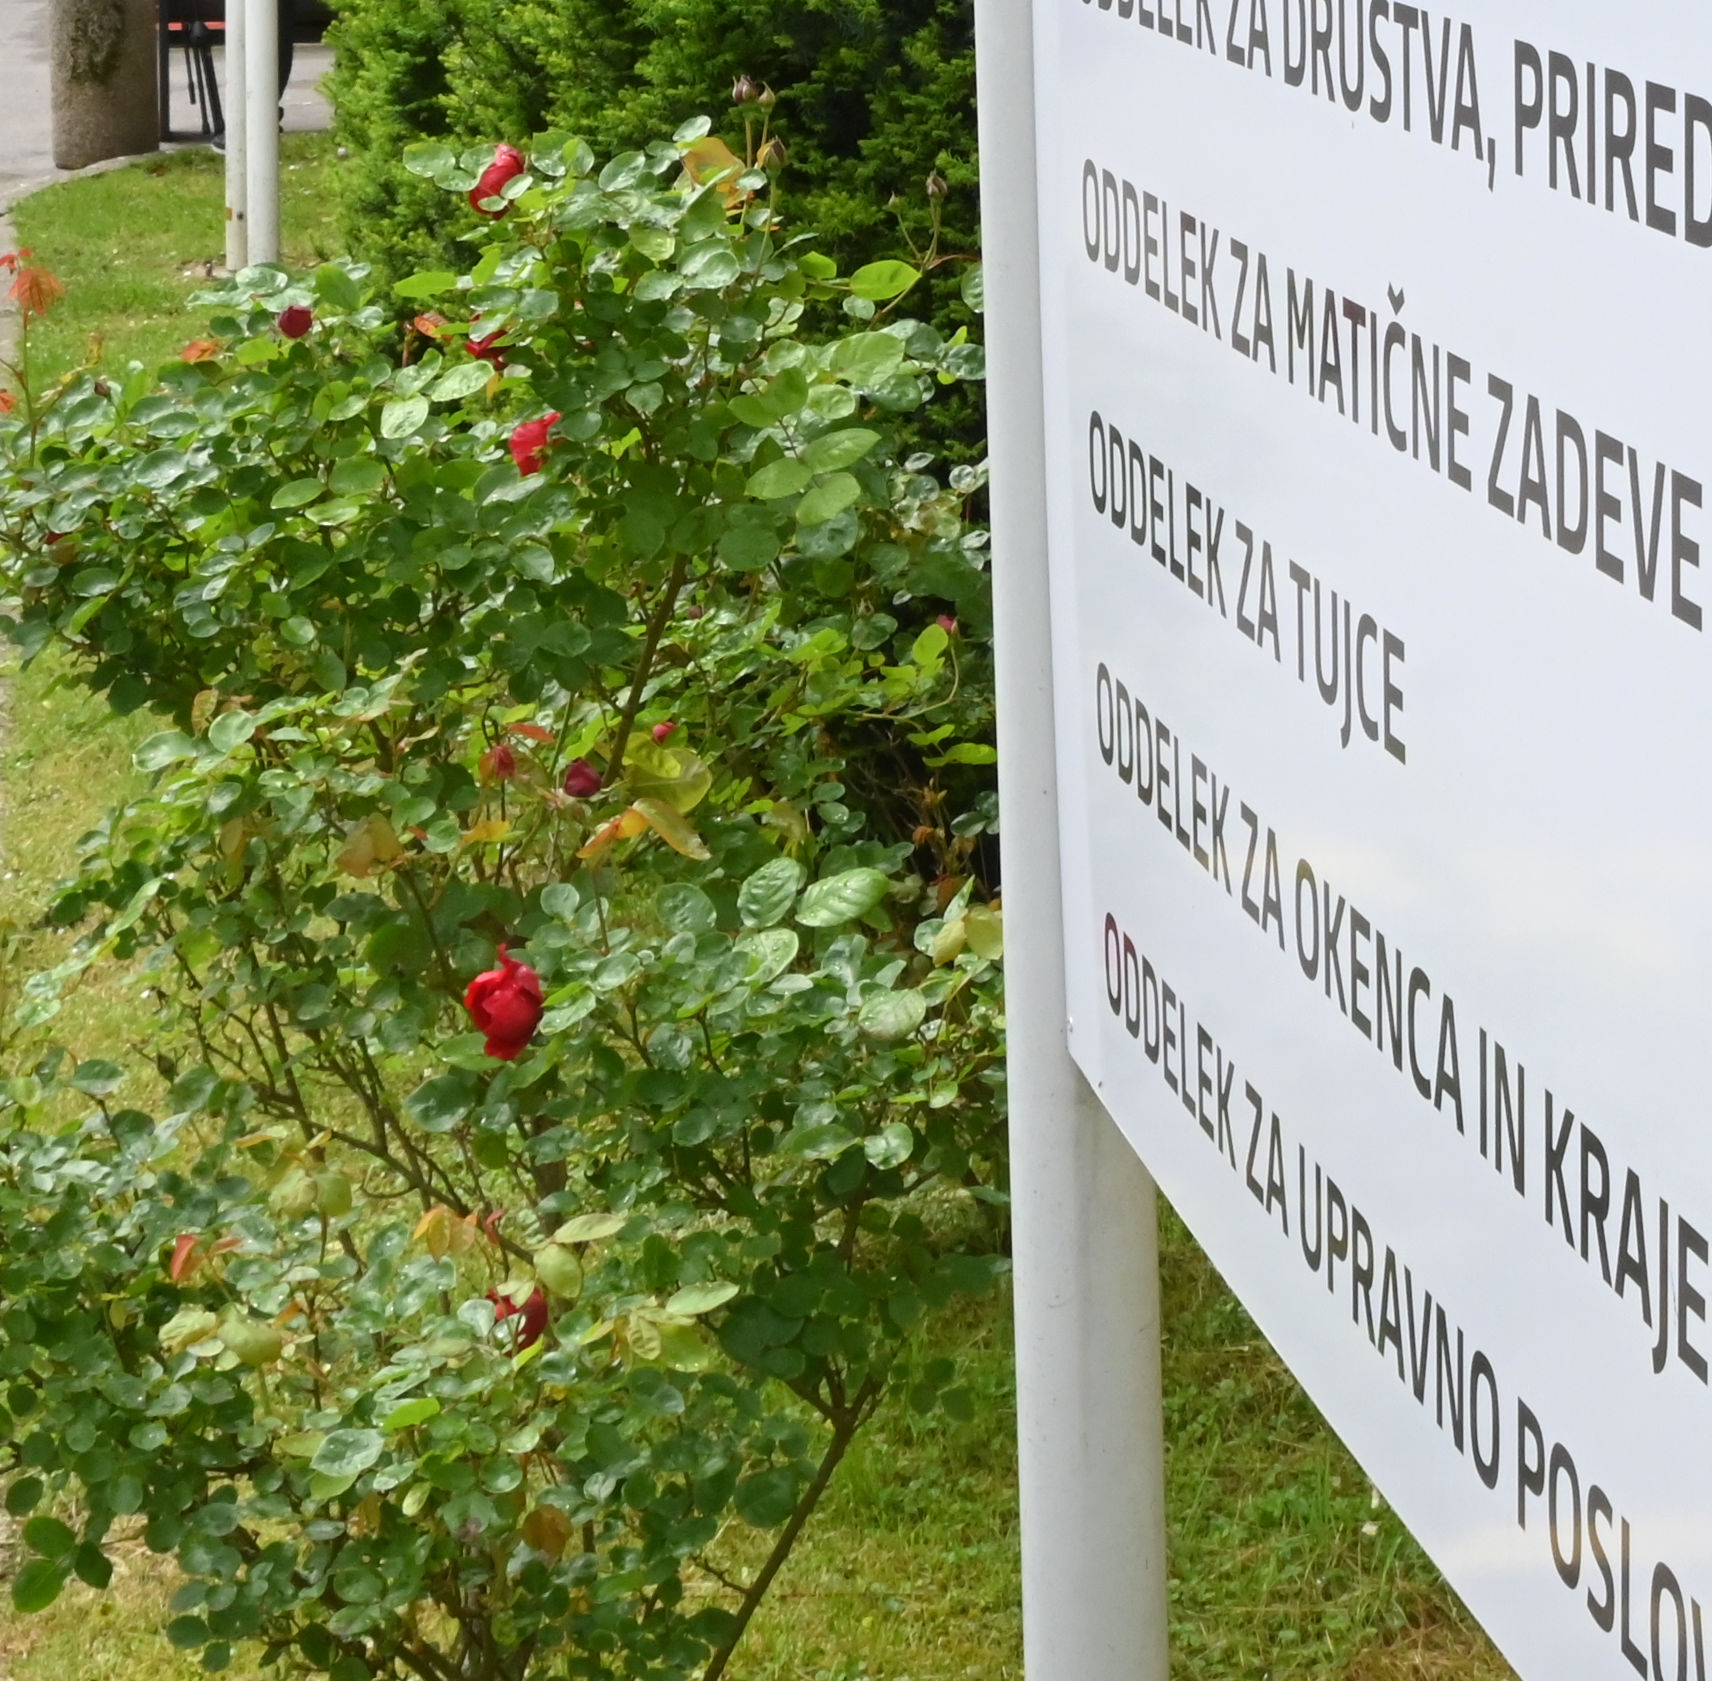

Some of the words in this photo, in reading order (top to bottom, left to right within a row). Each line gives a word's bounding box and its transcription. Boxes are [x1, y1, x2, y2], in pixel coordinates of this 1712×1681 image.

[1084, 160, 1221, 339] ODDELEK
[1231, 239, 1275, 373] ZA
[1288, 269, 1471, 491] MATIČNE
[1489, 374, 1702, 631] ZADEVE
[1090, 411, 1226, 617] ODDELEK
[1236, 520, 1280, 662] ZA
[1290, 561, 1405, 764] TUJCE
[1097, 663, 1231, 894] ODDELEK
[1241, 802, 1285, 950] ZA
[1296, 860, 1464, 1135] OKENCA
[1480, 1028, 1524, 1197] IN
[1105, 913, 1236, 1170] ODDELEK
[1246, 1081, 1288, 1237] ZA
[1300, 1145, 1499, 1489] UPRAVNO
